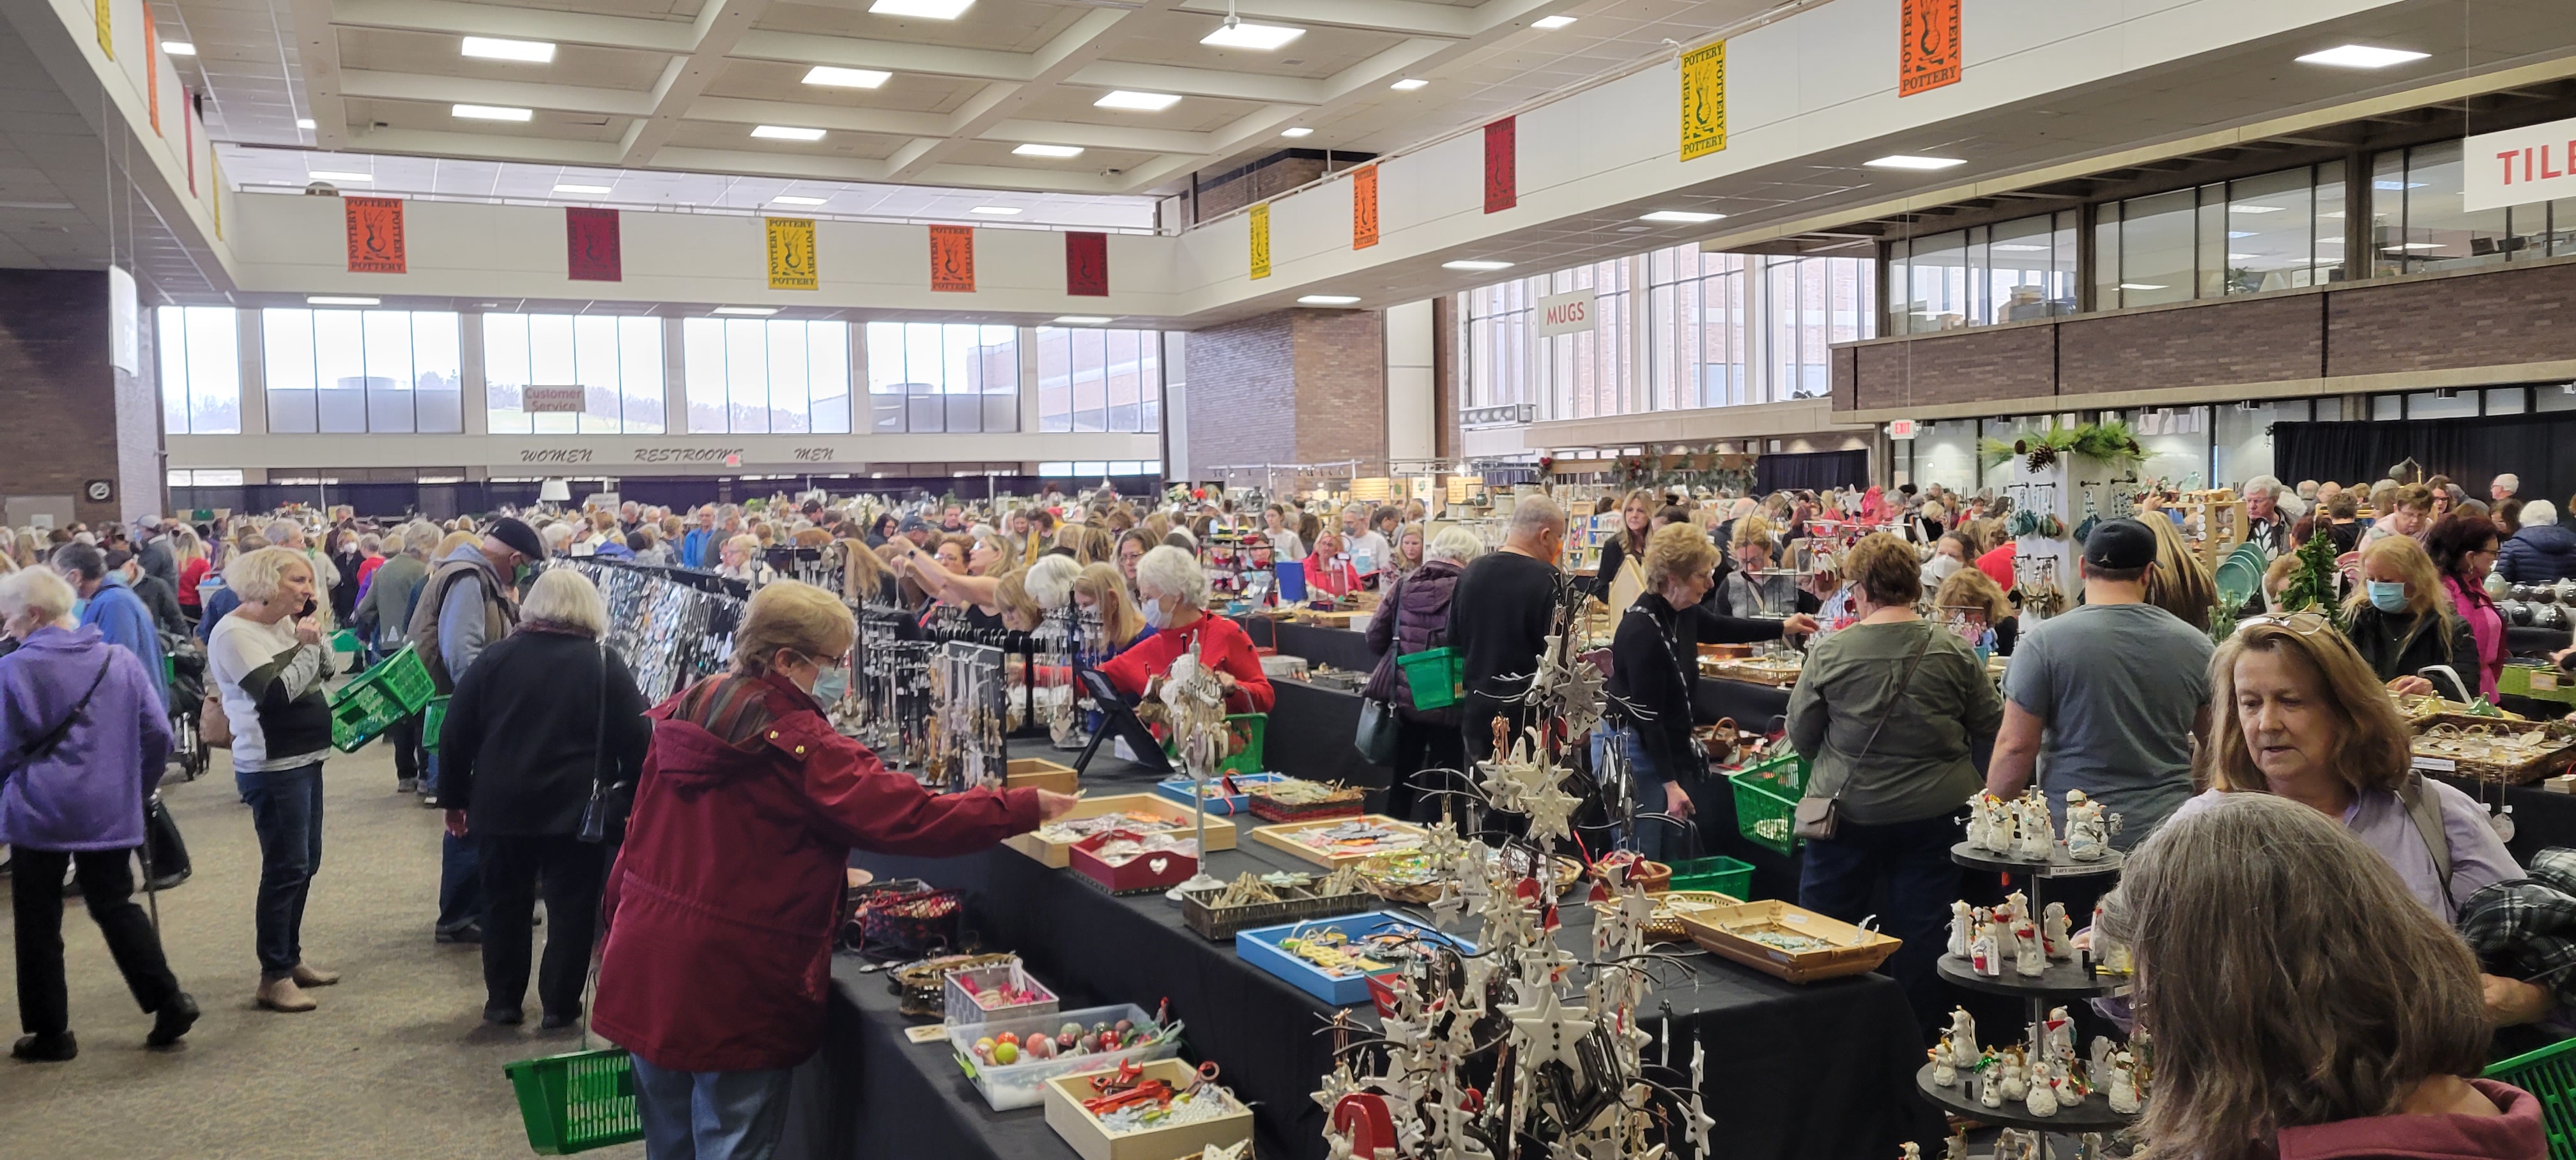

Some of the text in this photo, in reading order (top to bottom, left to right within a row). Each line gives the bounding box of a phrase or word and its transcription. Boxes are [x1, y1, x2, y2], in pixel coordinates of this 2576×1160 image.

[1683, 44, 1723, 68] POTTERY
[1902, 65, 1958, 91] POTTERY
[1683, 134, 1723, 155] POTTERY
[348, 199, 399, 208] POTTERY
[348, 210, 359, 260] POTTERY
[392, 210, 402, 260] POTTERY
[769, 229, 779, 275] POTTERY
[806, 230, 815, 275] POTTERY
[351, 262, 402, 270] POTTERY
[1546, 301, 1584, 326] MUGS
[525, 387, 582, 399] Customer
[532, 400, 576, 411] Service
[1895, 422, 1910, 434] EXIT
[520, 448, 593, 463] WOMEN
[794, 448, 834, 461] MEN
